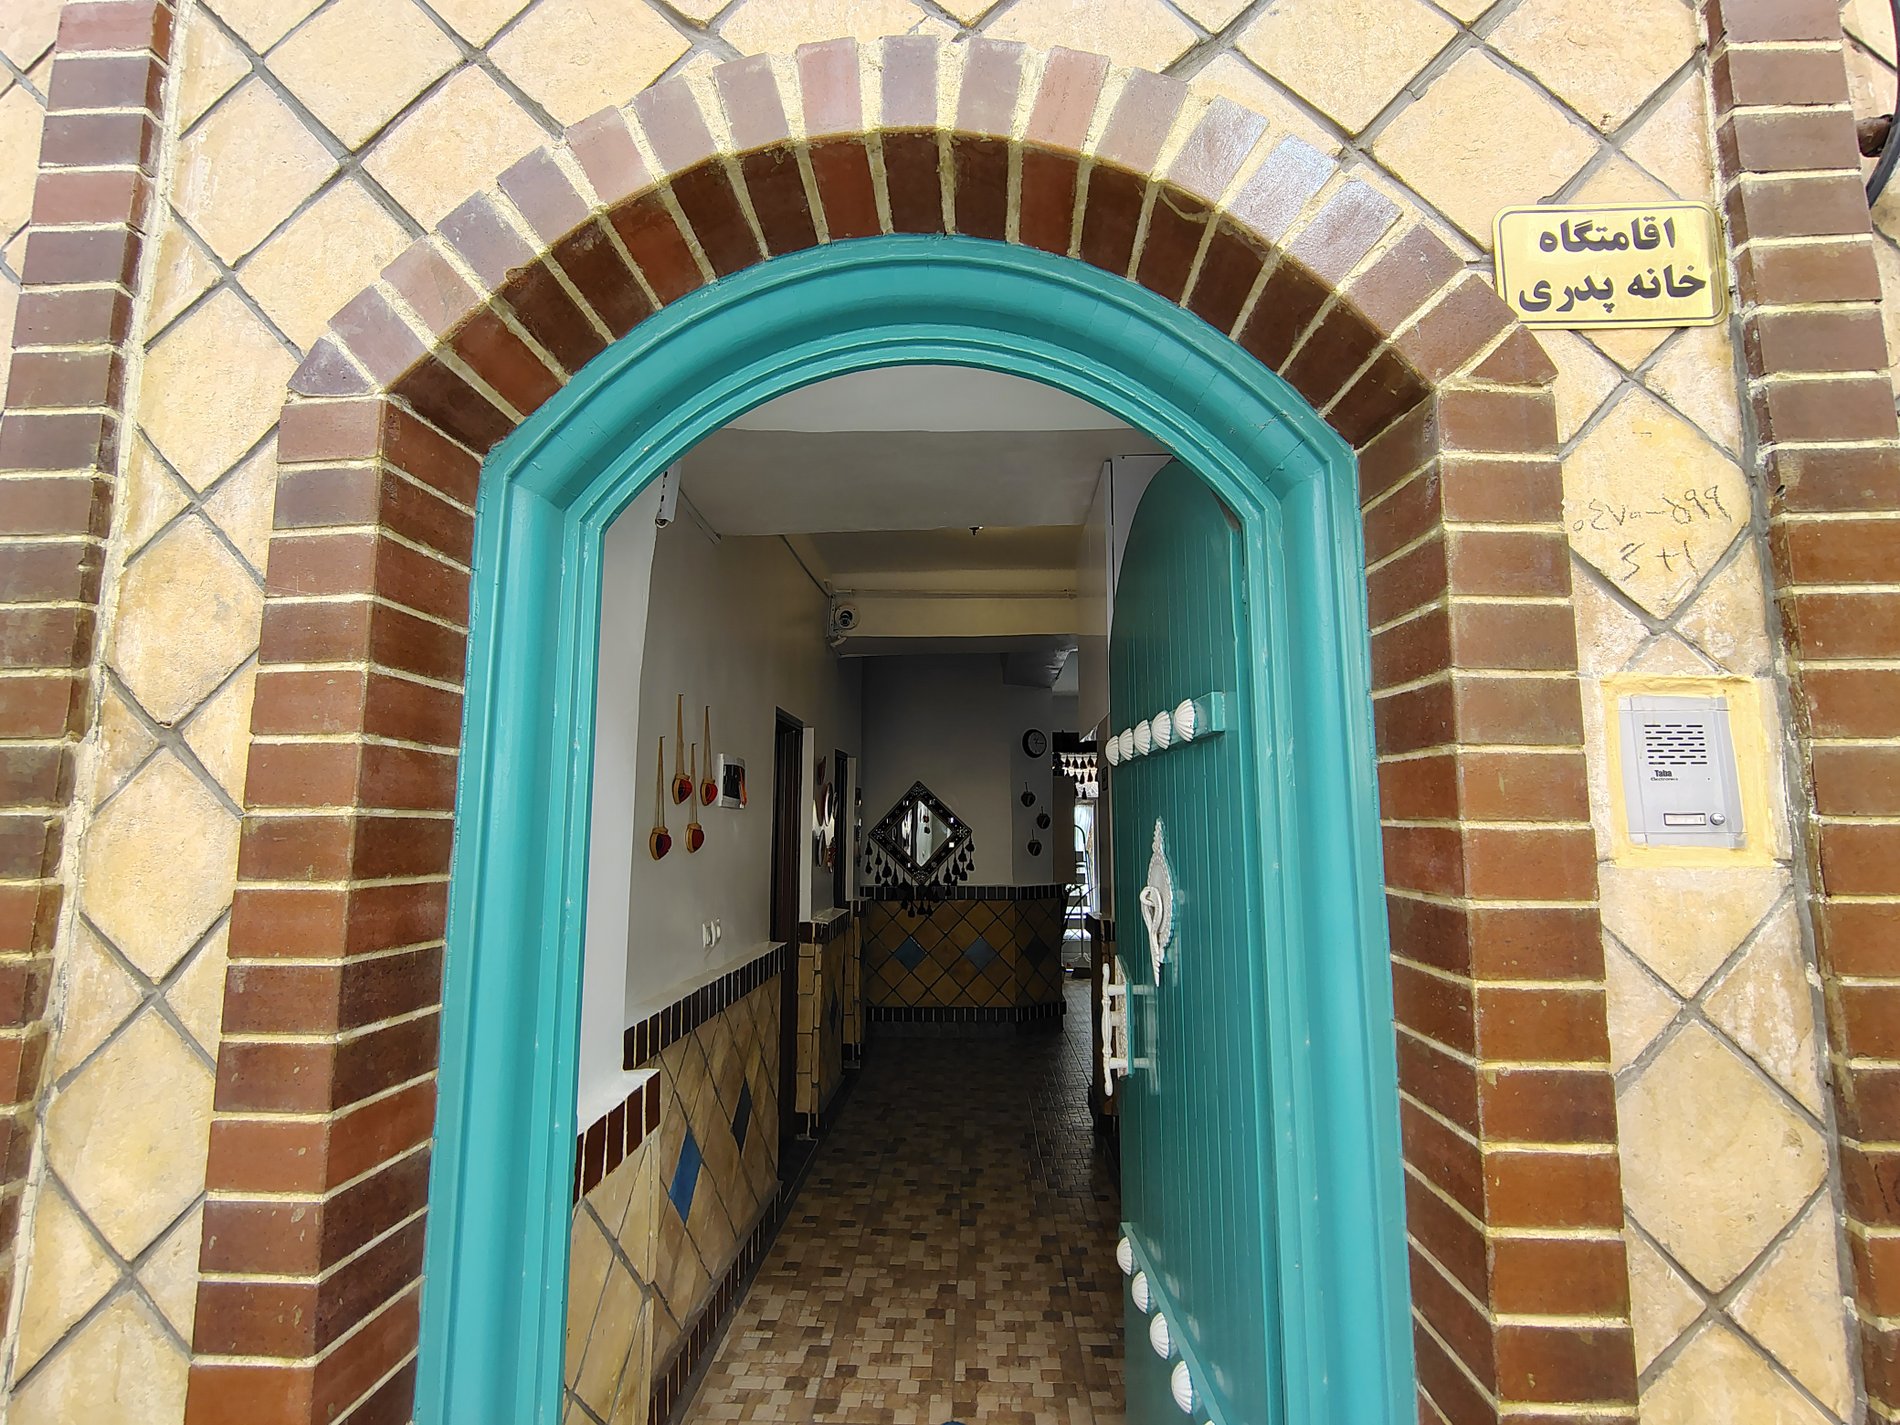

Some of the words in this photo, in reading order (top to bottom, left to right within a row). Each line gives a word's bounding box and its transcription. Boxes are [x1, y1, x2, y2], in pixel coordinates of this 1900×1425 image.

[1539, 216, 1676, 253] اقامتگاه
[1519, 275, 1615, 313] پدری
[1627, 264, 1707, 299] خانه
[1654, 769, 1673, 777] Taba
